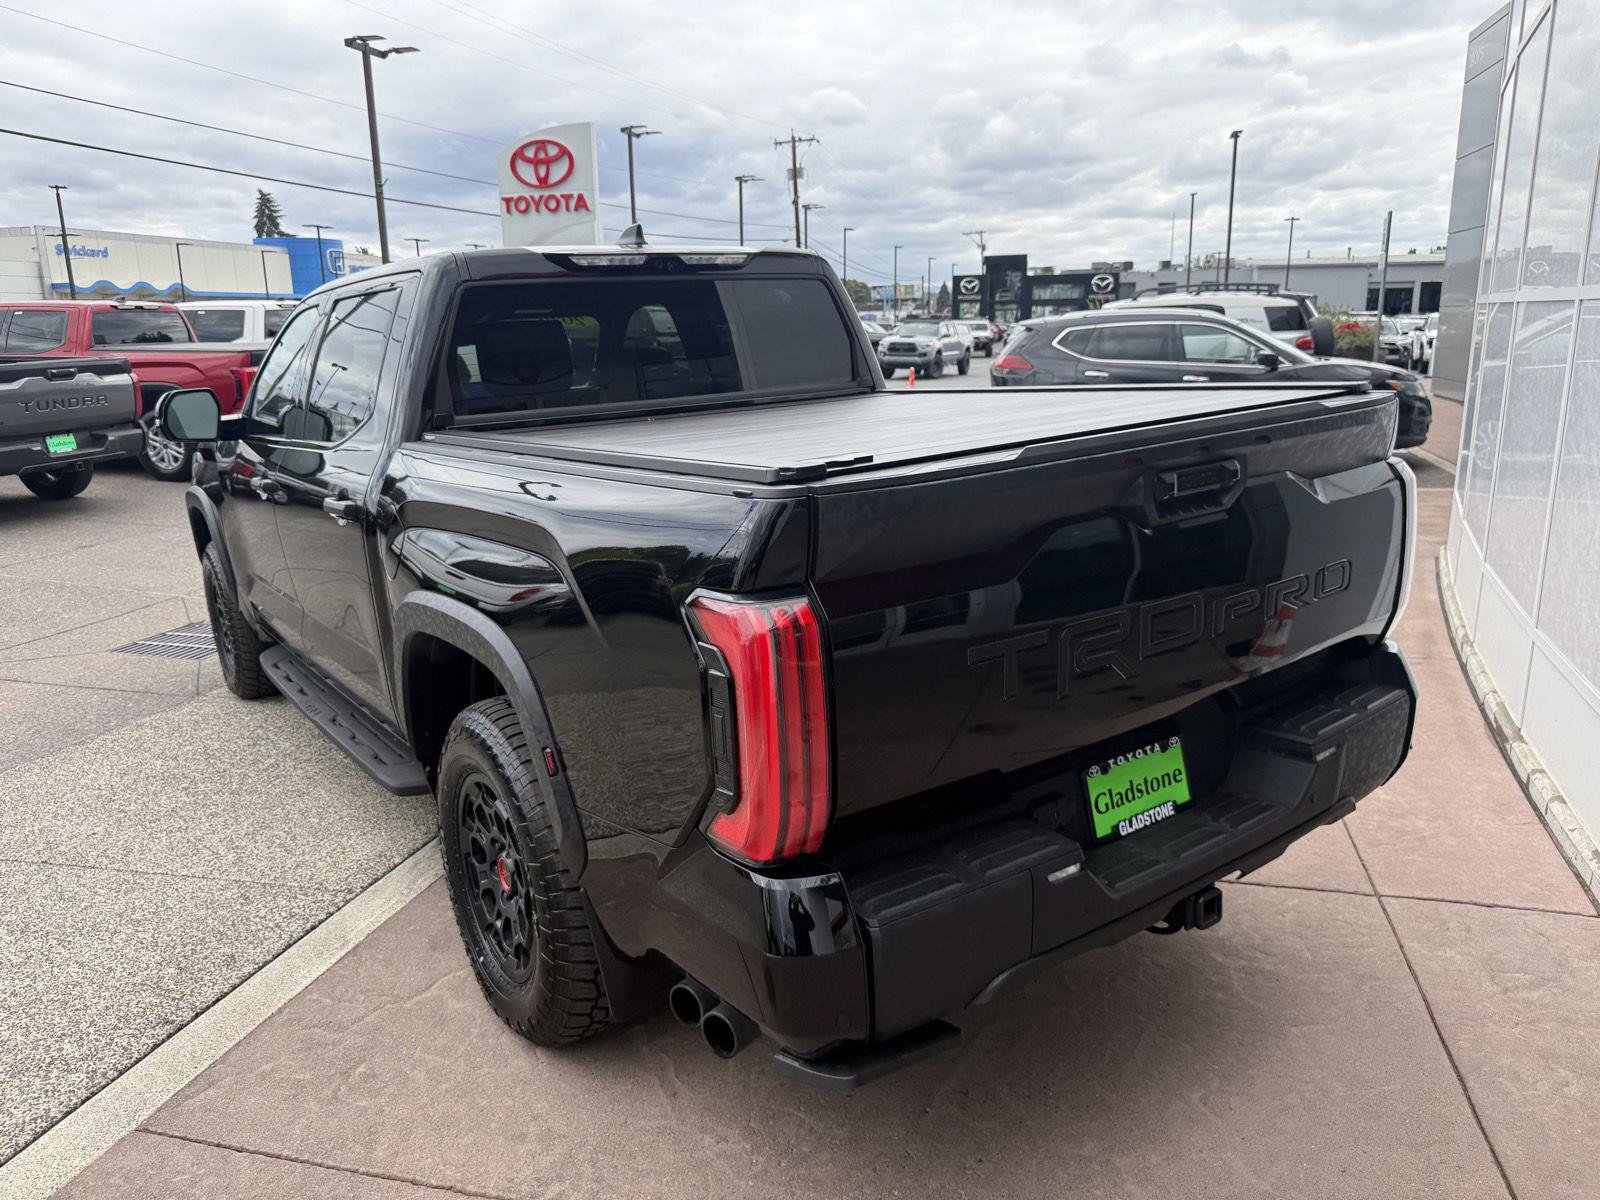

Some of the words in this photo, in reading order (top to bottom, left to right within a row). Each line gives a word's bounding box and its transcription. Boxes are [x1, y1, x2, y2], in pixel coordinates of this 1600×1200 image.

[501, 192, 590, 214] TOYOTA
[18, 395, 108, 414] TUNDRA
[1107, 742, 1161, 769] TOYOTA
[1093, 767, 1183, 815] Gladstone
[1118, 800, 1176, 837] GLADSTONE
